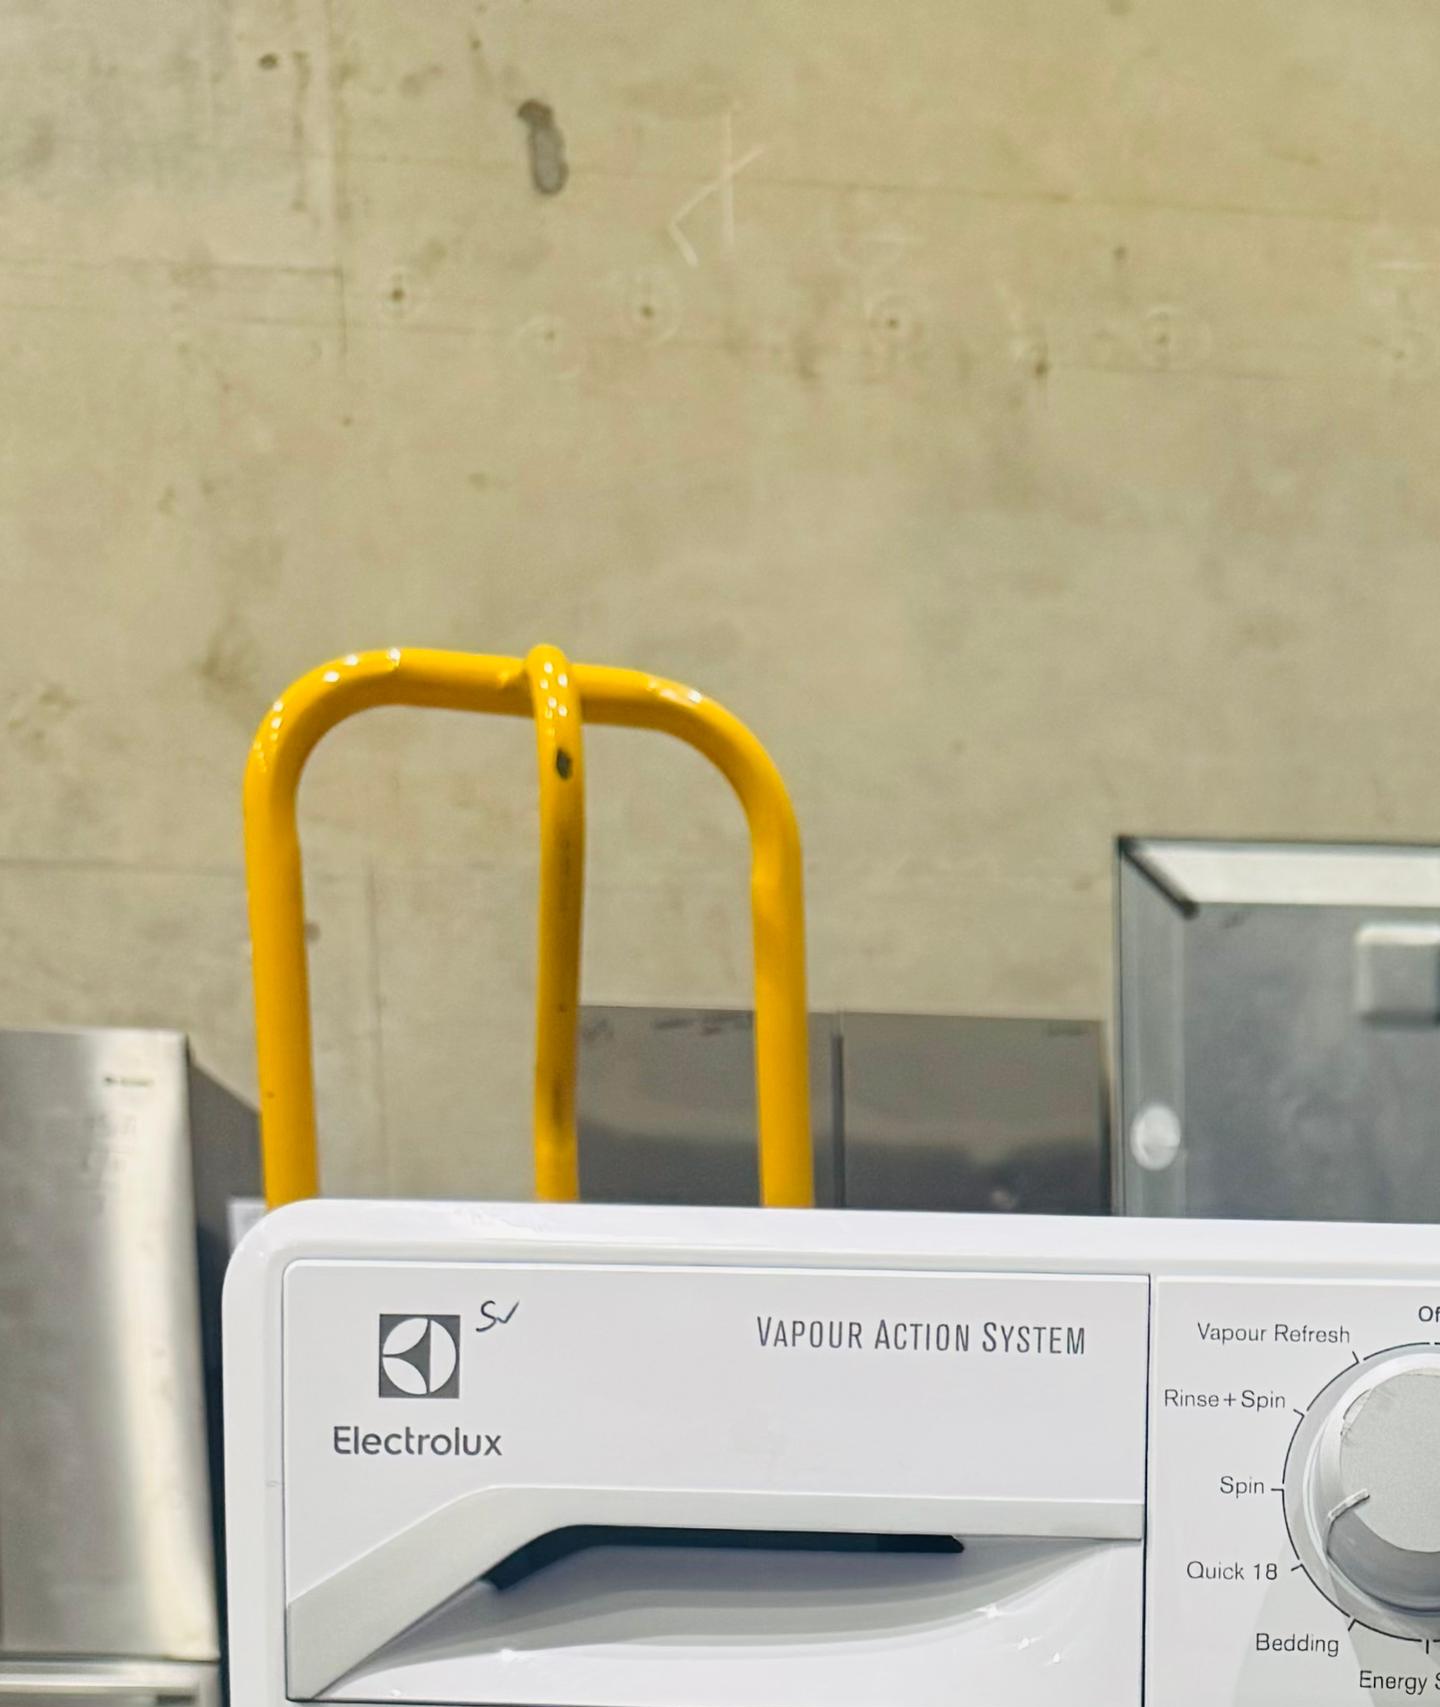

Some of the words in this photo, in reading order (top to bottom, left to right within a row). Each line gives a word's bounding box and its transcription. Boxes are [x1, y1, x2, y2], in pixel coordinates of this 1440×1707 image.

[757, 1316, 863, 1350] VAPOUR
[874, 1319, 970, 1352] ACTION
[982, 1322, 1086, 1355] SYSTEM
[1197, 1322, 1267, 1346] Vapour
[1273, 1324, 1351, 1344] Refresh
[333, 1425, 503, 1456] Electrolux
[1219, 1476, 1265, 1498] Spin
[1186, 1560, 1244, 1581] Quick
[1253, 1562, 1278, 1581] 18
[1255, 1633, 1340, 1658] Bedding
[1359, 1670, 1427, 1695] Energy
